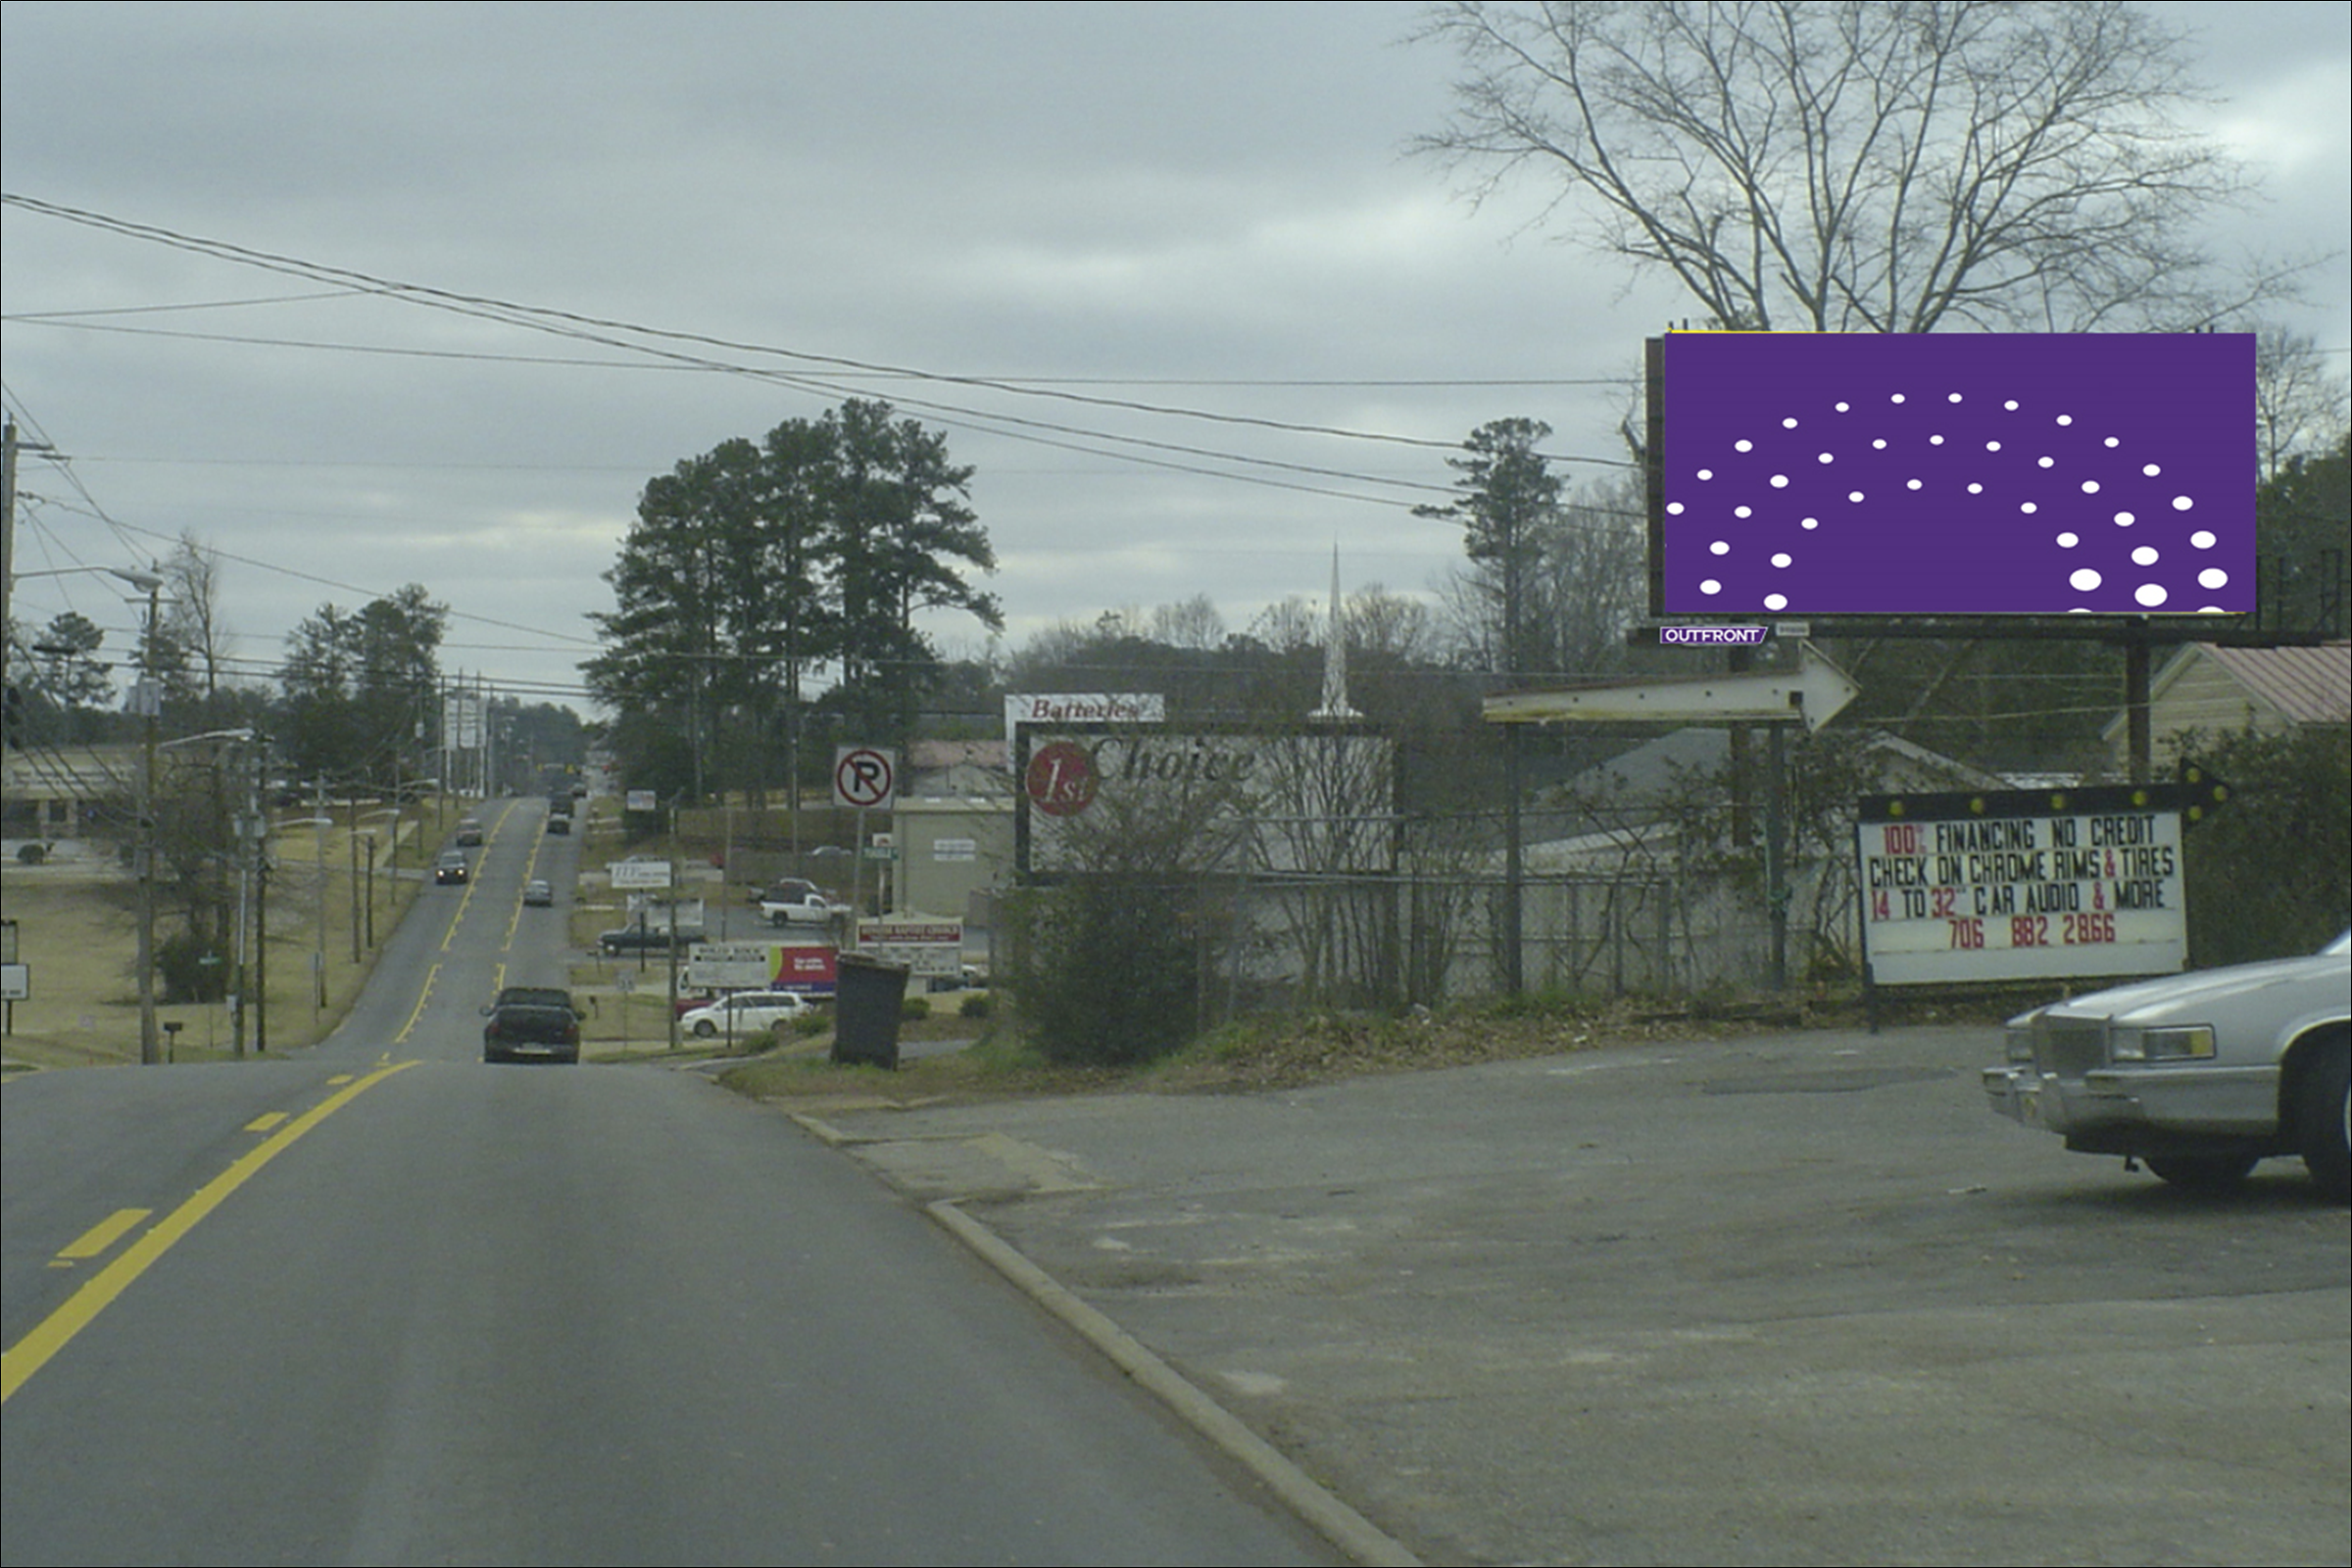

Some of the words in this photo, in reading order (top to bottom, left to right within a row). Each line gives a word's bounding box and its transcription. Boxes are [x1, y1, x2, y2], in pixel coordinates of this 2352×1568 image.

[1665, 629, 1759, 642] OUTFRONT
[1032, 699, 1140, 718] Batteries
[1091, 737, 1256, 782] Choice
[1936, 820, 2034, 853] FINANCING
[2051, 818, 2076, 848] NO
[2090, 814, 2155, 846] CREDIT
[1869, 856, 1929, 887] CHECK
[1936, 855, 1963, 885] ON
[1969, 852, 2045, 884] CHROME
[2054, 850, 2100, 879] RIMS
[2104, 848, 2116, 877] &
[2120, 846, 2174, 877] TIRES
[1871, 889, 1889, 920] 14
[1901, 888, 1926, 918] TO
[1974, 885, 2015, 915] CAR
[2027, 882, 2080, 914] AUDIO
[2092, 880, 2104, 910] &
[2114, 879, 2165, 909] MORE
[1948, 918, 1984, 949] 706
[2012, 915, 2048, 946] 882
[2063, 912, 2116, 944] 2866
